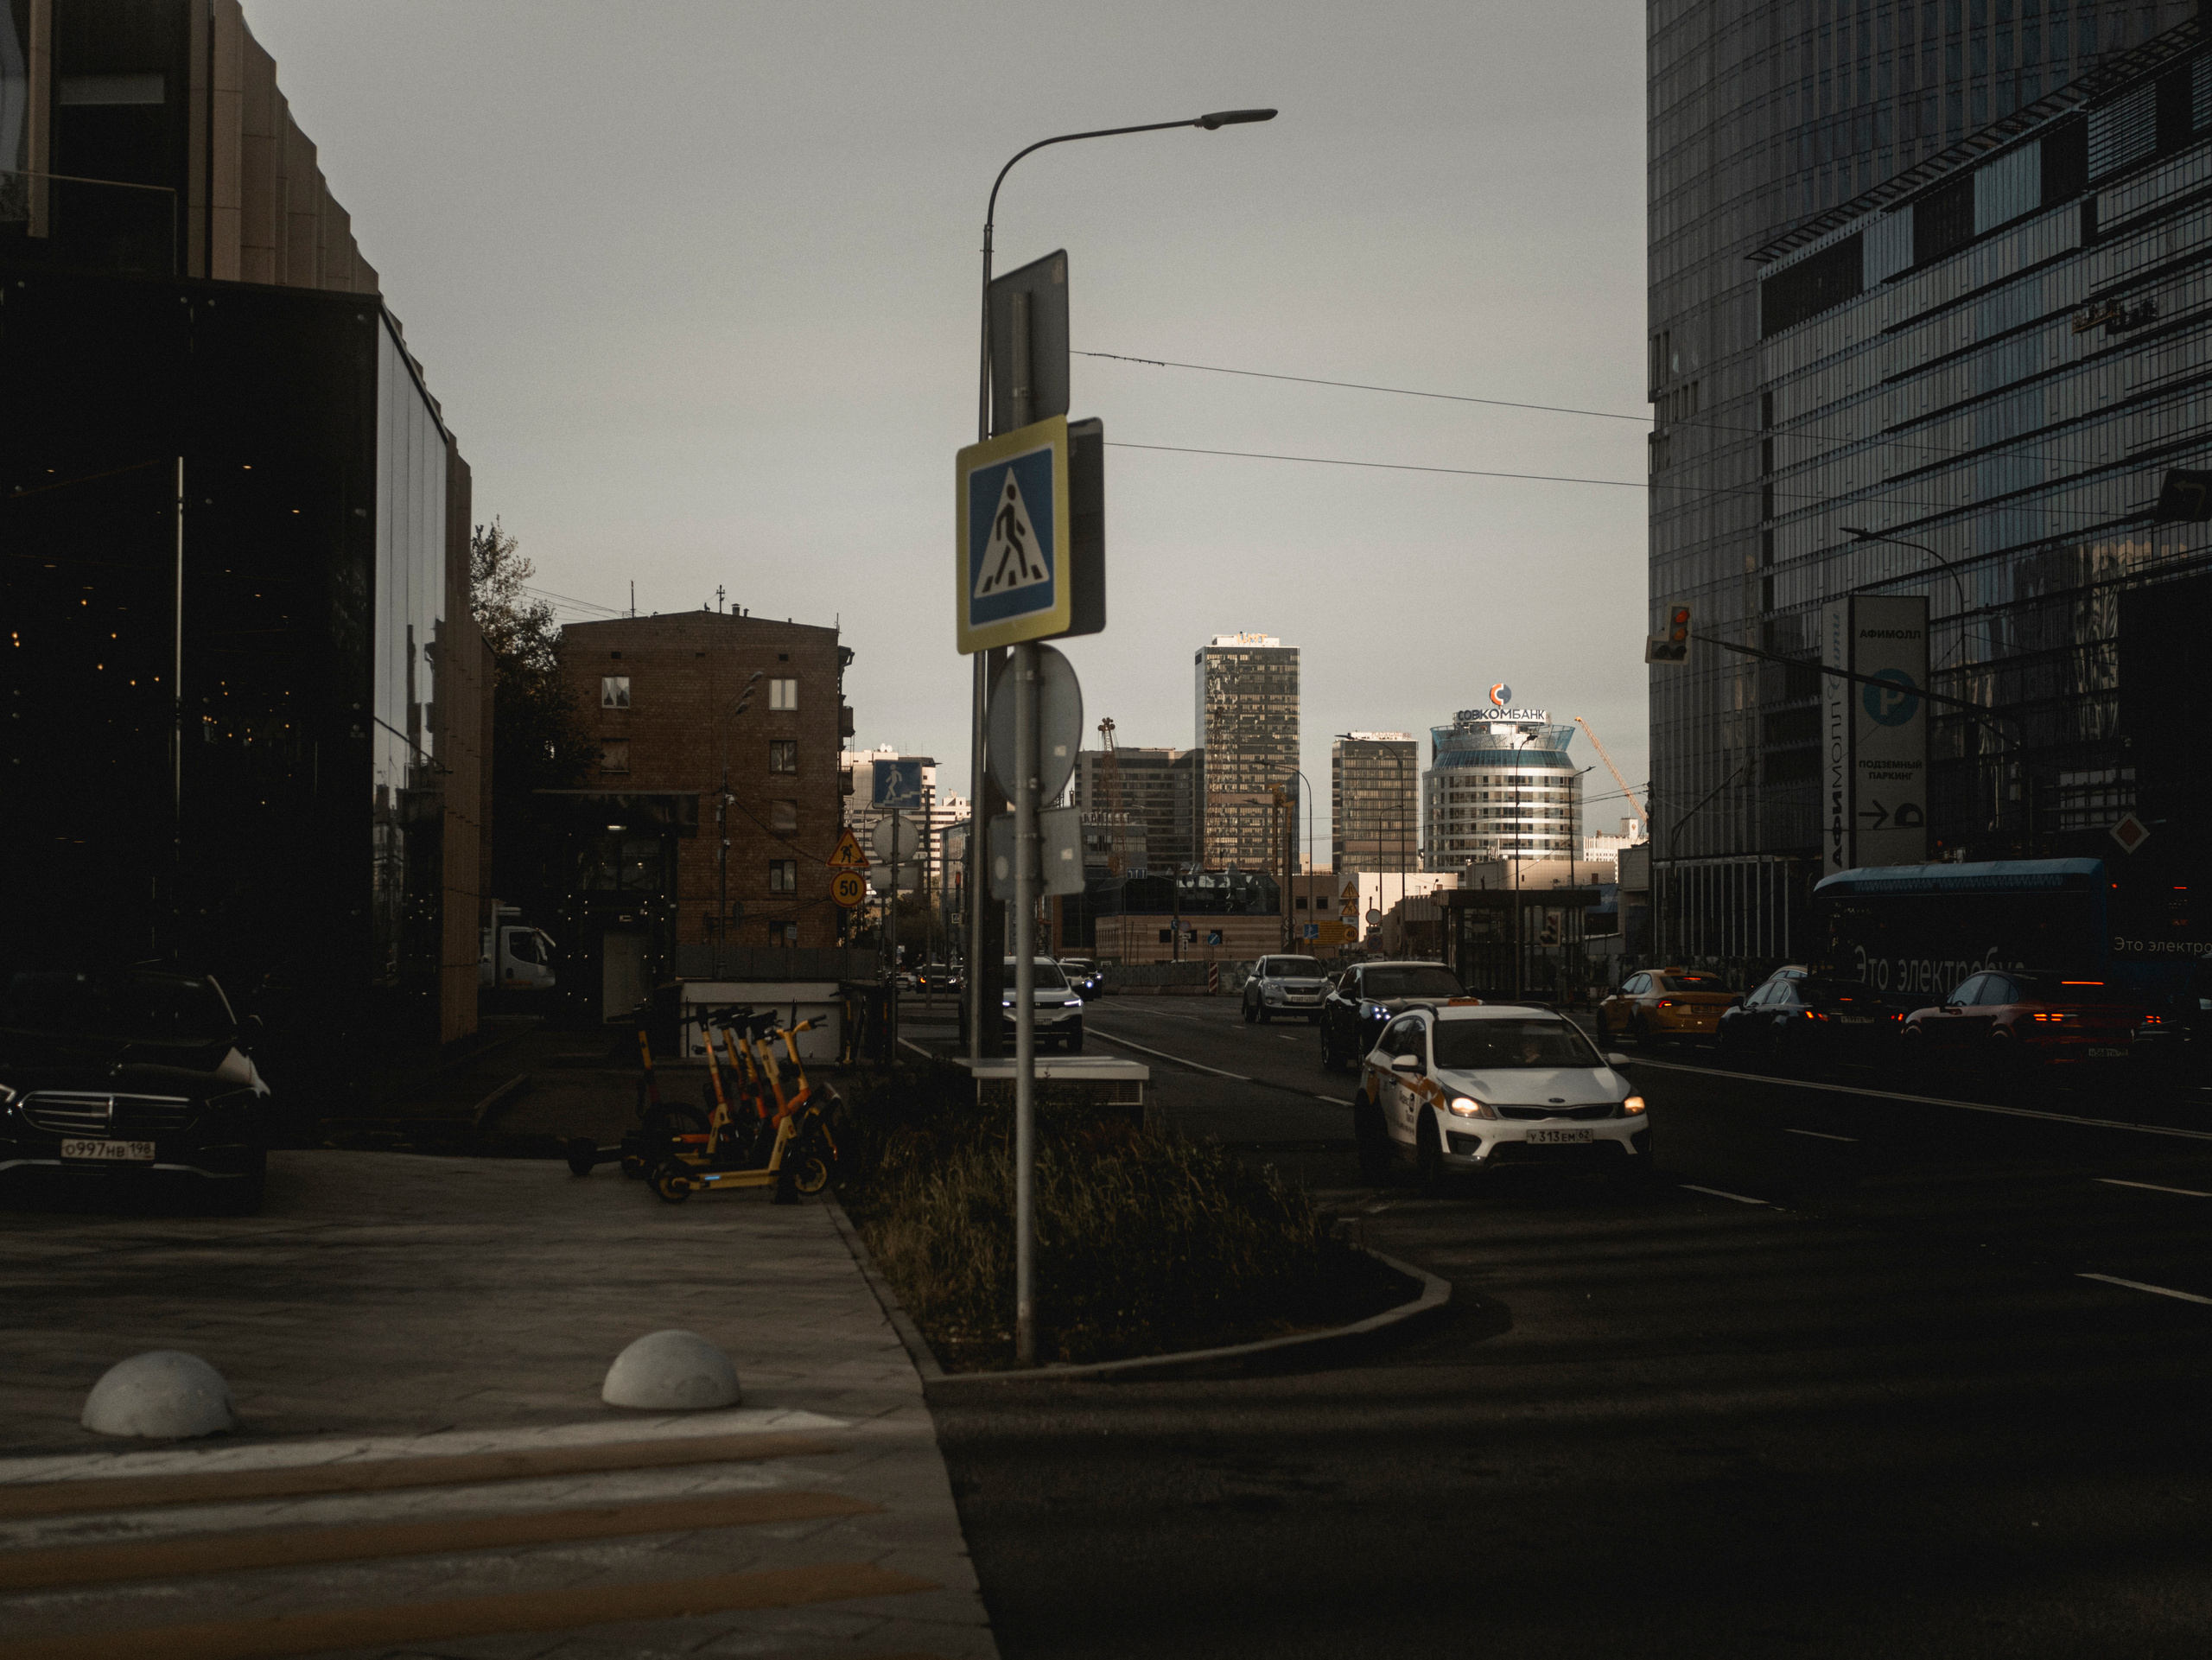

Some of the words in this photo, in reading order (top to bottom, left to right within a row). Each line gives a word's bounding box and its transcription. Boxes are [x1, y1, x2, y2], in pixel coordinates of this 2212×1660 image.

[1859, 629, 1921, 639] АФИМОЛЛ
[1458, 709, 1545, 722] СОВКОМБАНК
[1859, 760, 1923, 769] ПОДЗЕМНЫЙ
[840, 880, 858, 896] 50
[2114, 937, 2143, 951] Это
[2148, 940, 2212, 956] электро
[1854, 945, 1889, 991] Это
[130, 1142, 151, 1154] 198
